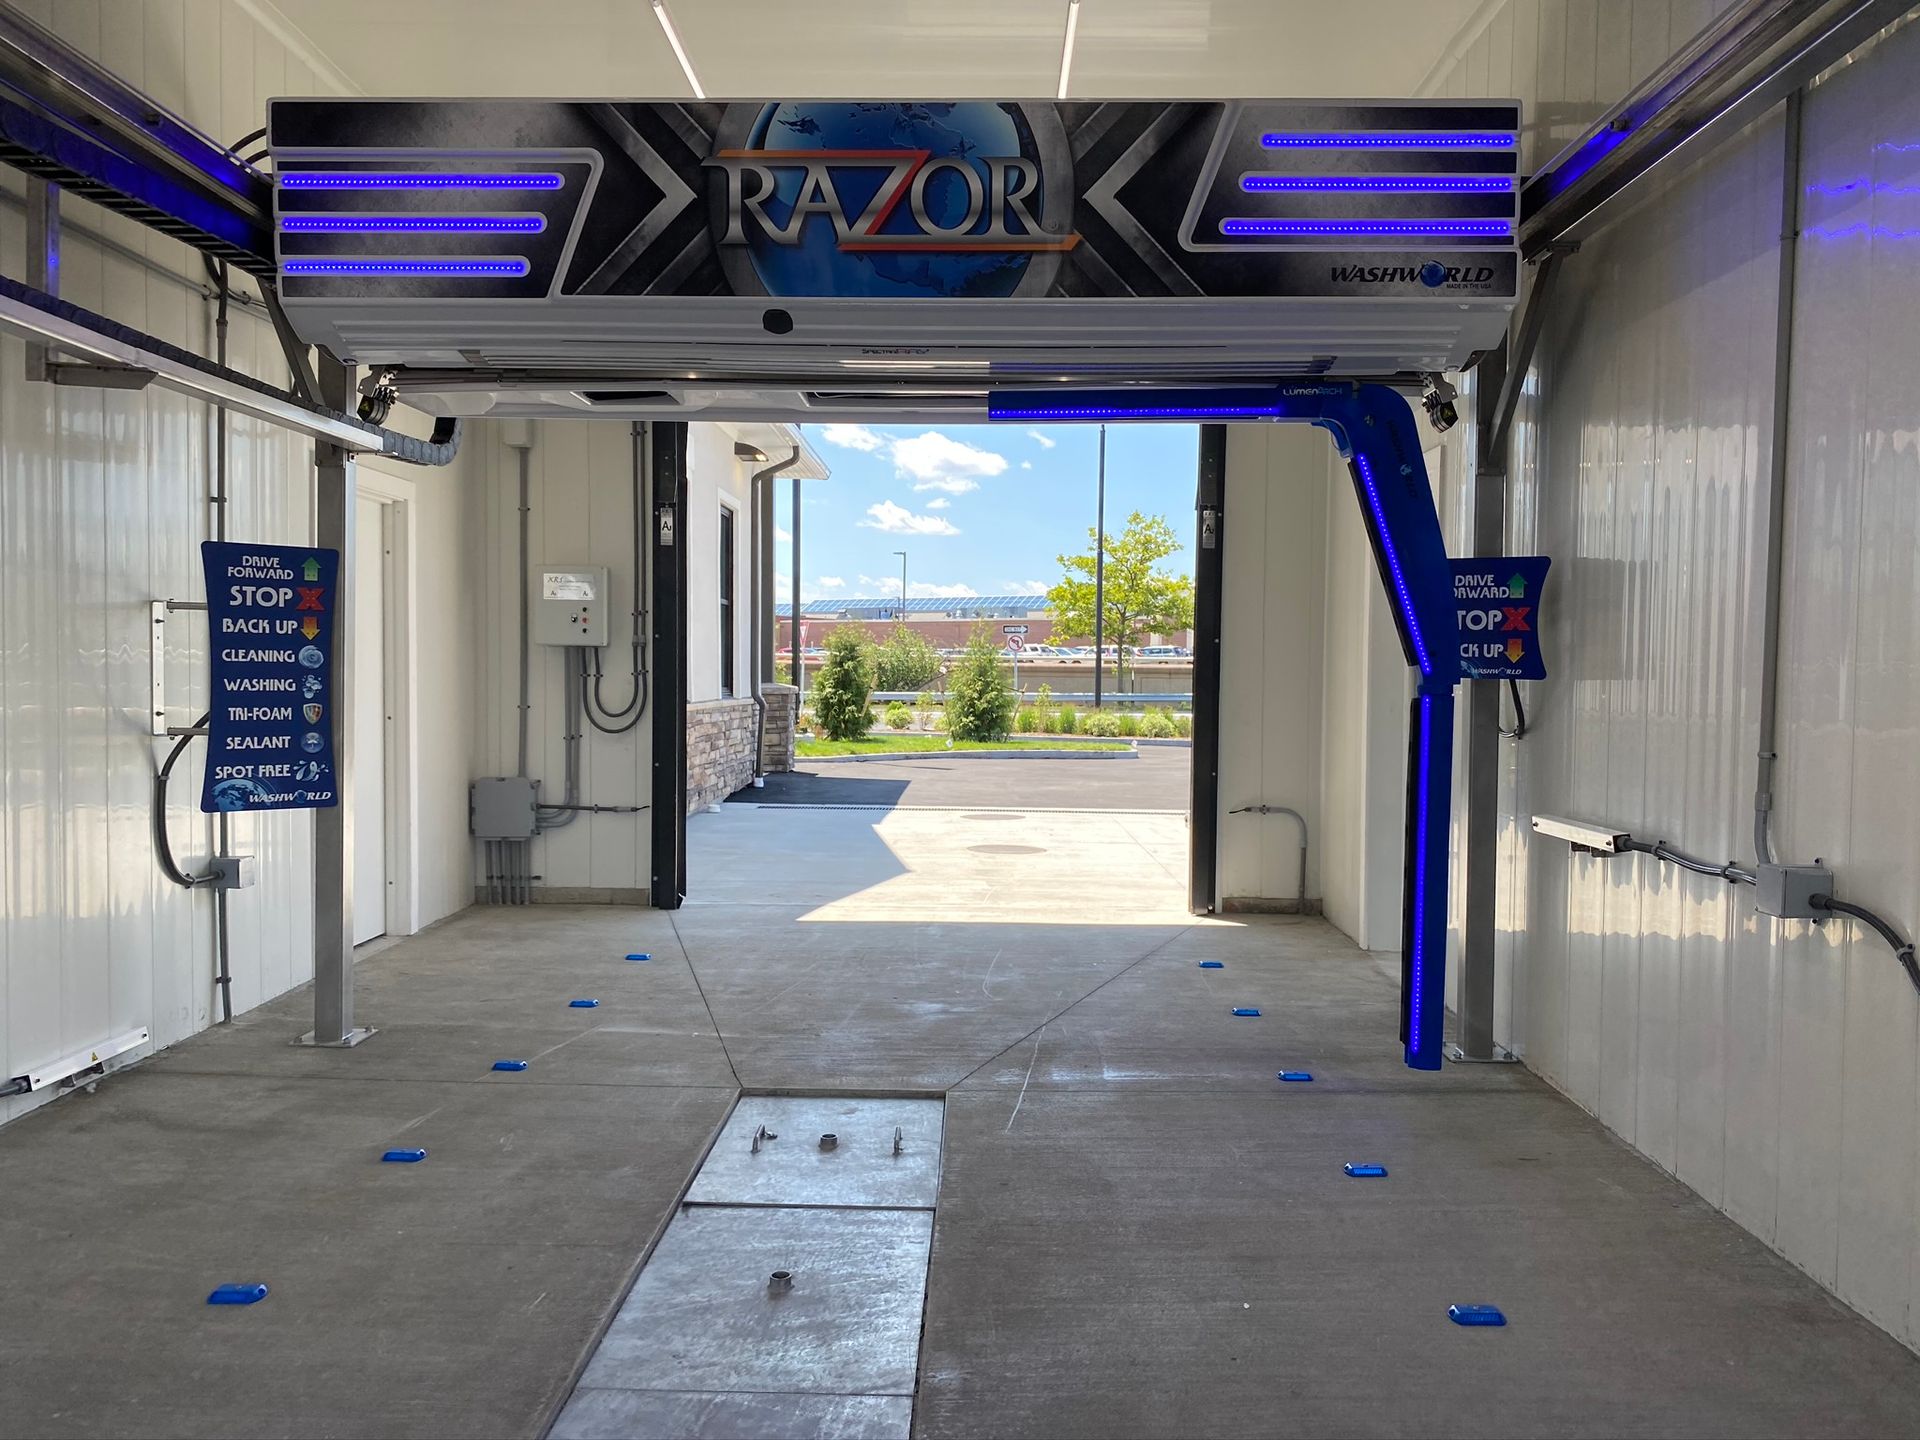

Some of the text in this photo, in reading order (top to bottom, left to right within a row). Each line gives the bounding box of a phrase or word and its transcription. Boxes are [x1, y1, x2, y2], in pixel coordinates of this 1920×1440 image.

[700, 153, 1072, 250] RAZOR
[242, 555, 281, 568] DRIVE
[227, 566, 294, 580] FORWARD
[1455, 574, 1494, 586] DRIVE
[229, 585, 293, 608] STOP
[1454, 586, 1509, 598] RWARD
[222, 617, 298, 635] BACK UP
[1457, 609, 1502, 631] TOP
[221, 648, 296, 663] CLEANING
[1460, 643, 1504, 658] CK UP
[223, 678, 296, 692] WASHING
[228, 707, 292, 721] TRI-FOAM
[226, 736, 291, 750] SEALANT
[215, 764, 291, 779] SPOT FREE
